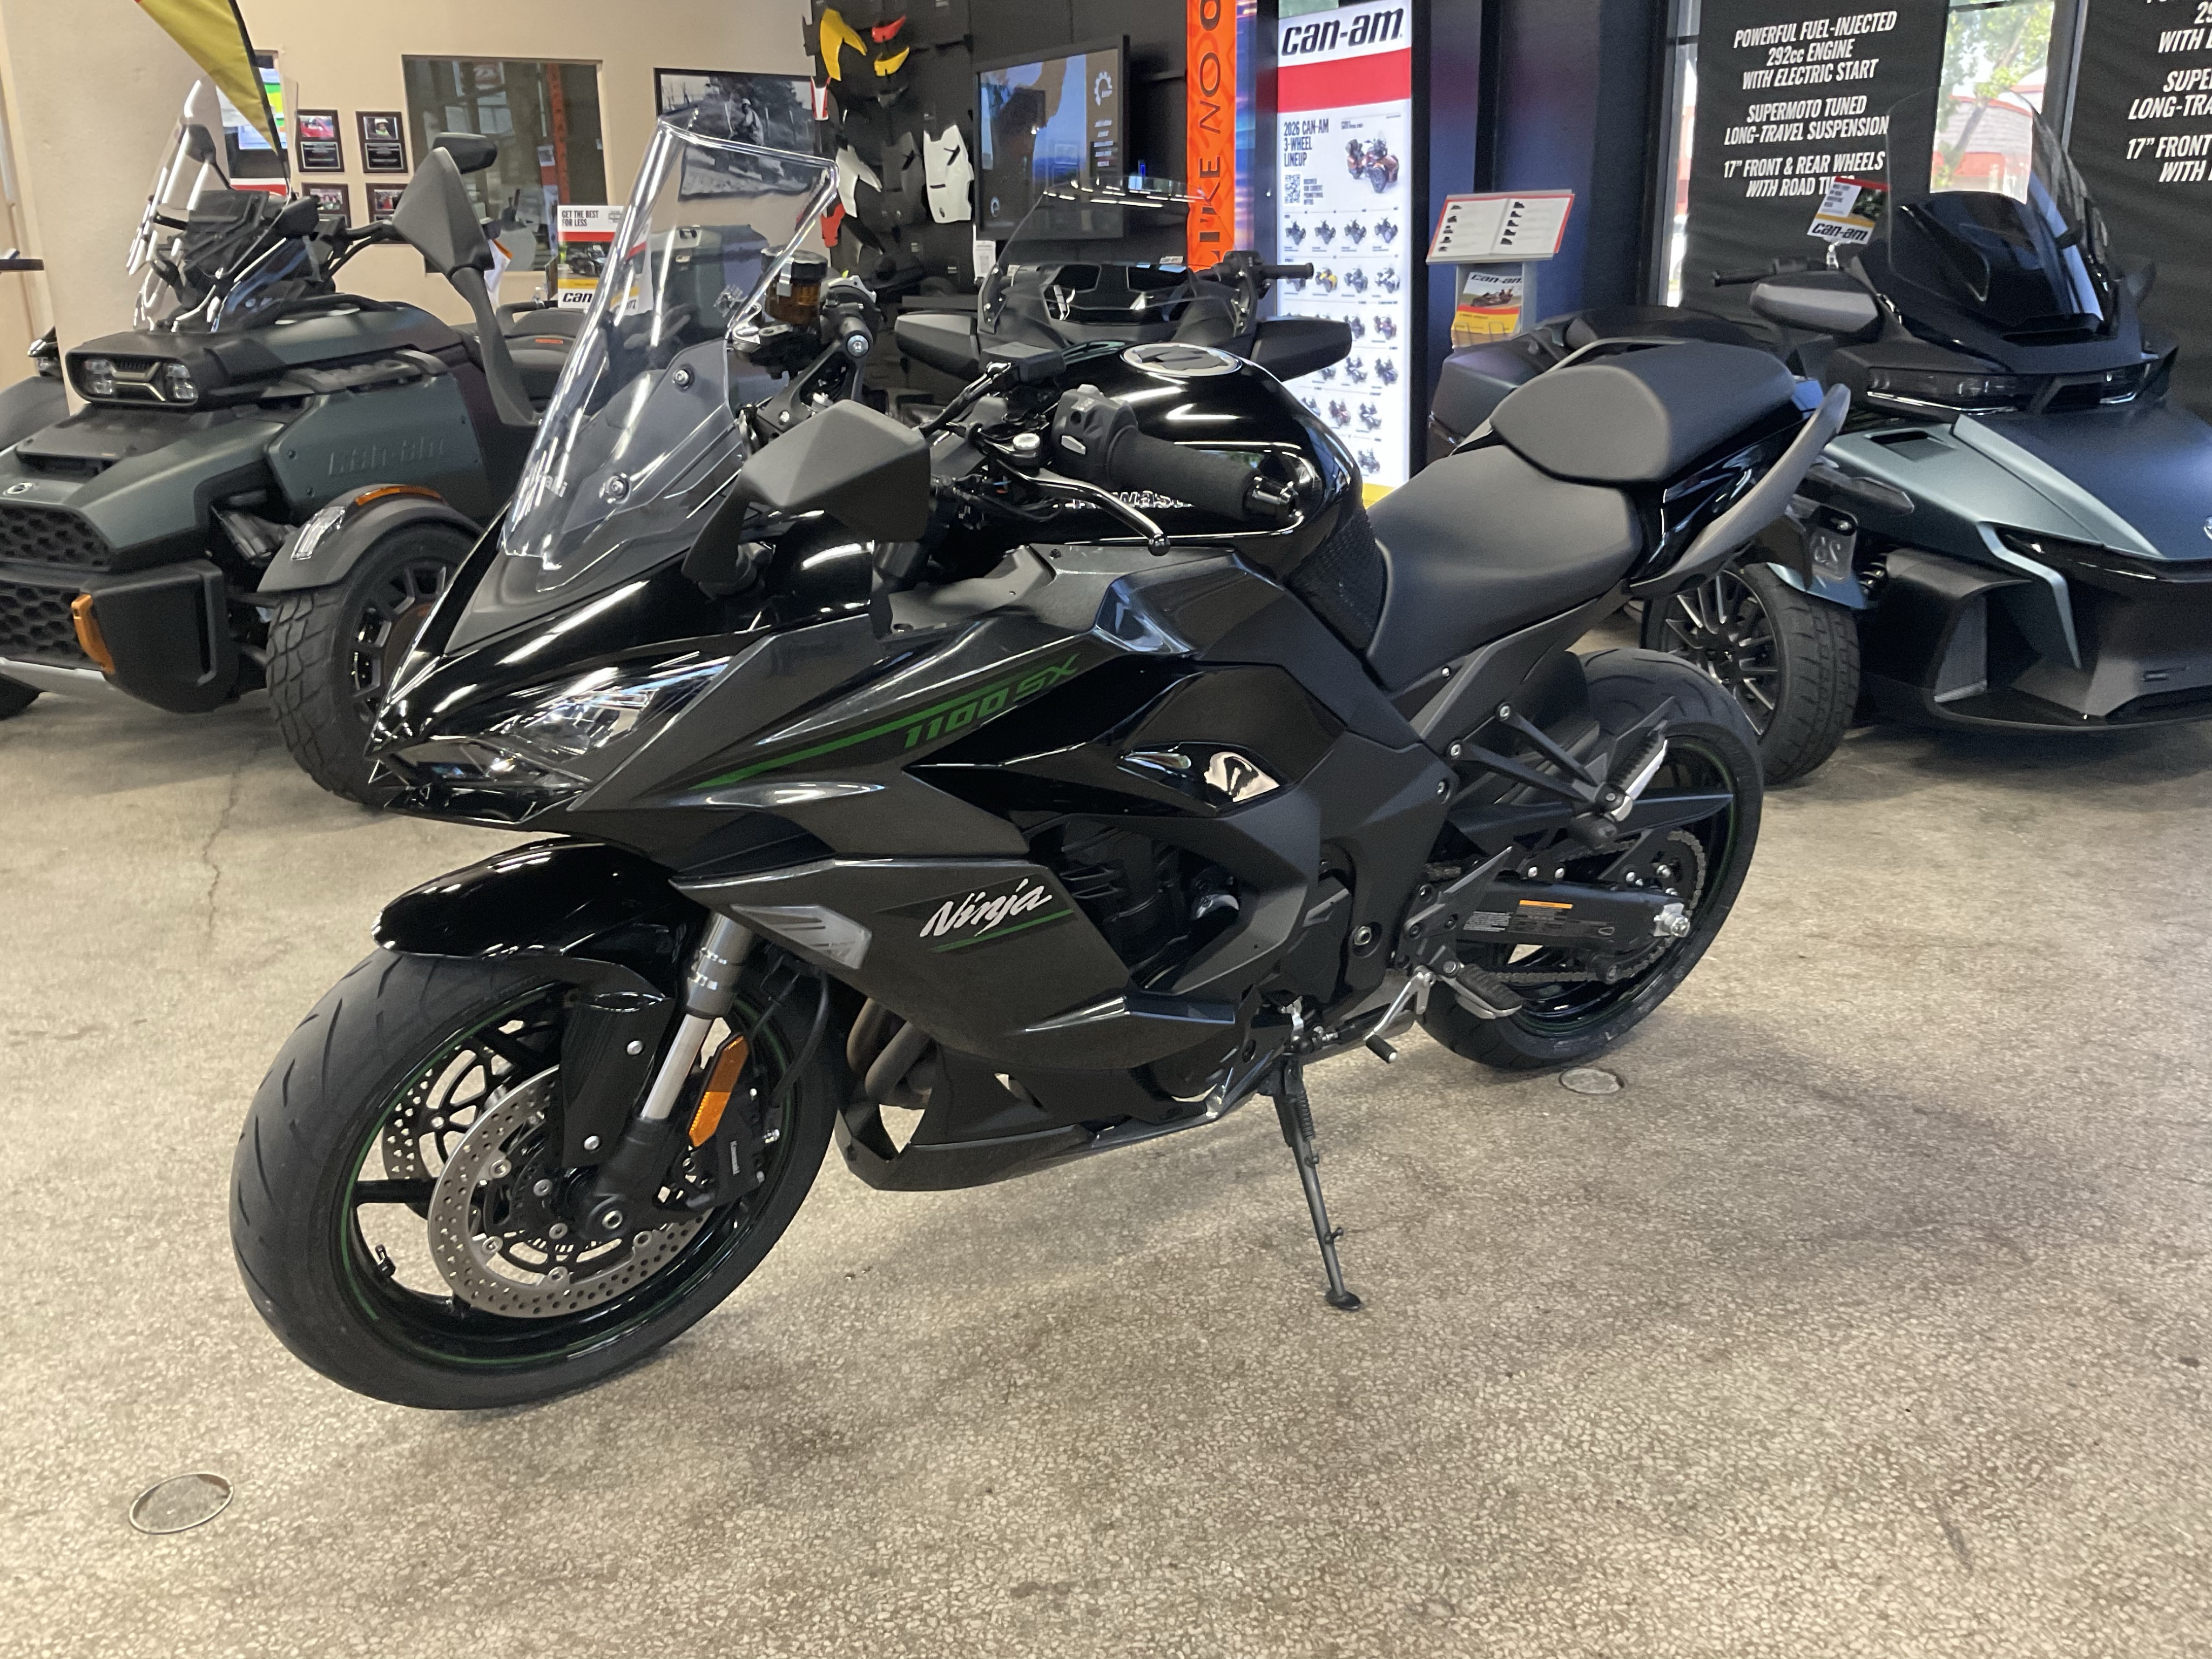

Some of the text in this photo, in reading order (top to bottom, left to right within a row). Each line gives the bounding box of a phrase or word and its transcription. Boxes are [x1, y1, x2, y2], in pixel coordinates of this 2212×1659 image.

[1281, 8, 1404, 56] can-am
[1734, 11, 1897, 49] POWERFUL FUEL-INJECTED
[2158, 28, 2205, 53] WITH
[1766, 38, 1856, 66] 292cc ENGINE
[1742, 58, 1879, 90] WITH ELECTRIC START
[2163, 68, 2212, 92] SUPE
[1199, 52, 1221, 134] NO
[1746, 95, 1867, 123] SUPERMOTO TUNED
[1284, 120, 1300, 136] 2026
[1301, 118, 1330, 135] CAN-AM
[1724, 116, 1890, 145] LONG-TRAVEL SUSPENSION
[1284, 136, 1312, 152] 3-WHEEL
[2155, 134, 2212, 158] FRONT
[1284, 152, 1307, 167] LINEUP
[1743, 158, 1783, 177] FRONT
[1784, 157, 1793, 175] &
[1796, 154, 1830, 174] REAR
[1833, 151, 1886, 173] WHEELS
[2159, 160, 2207, 182] WITH
[1746, 179, 1779, 198] WITH
[1779, 177, 1816, 196] ROAD
[562, 210, 572, 218] GET
[574, 210, 584, 218] THE
[585, 210, 599, 218] BEST
[1199, 156, 1220, 262] IKE
[574, 219, 588, 227] LESS
[1811, 223, 1869, 241] can-am
[919, 878, 1053, 938] Ninja
